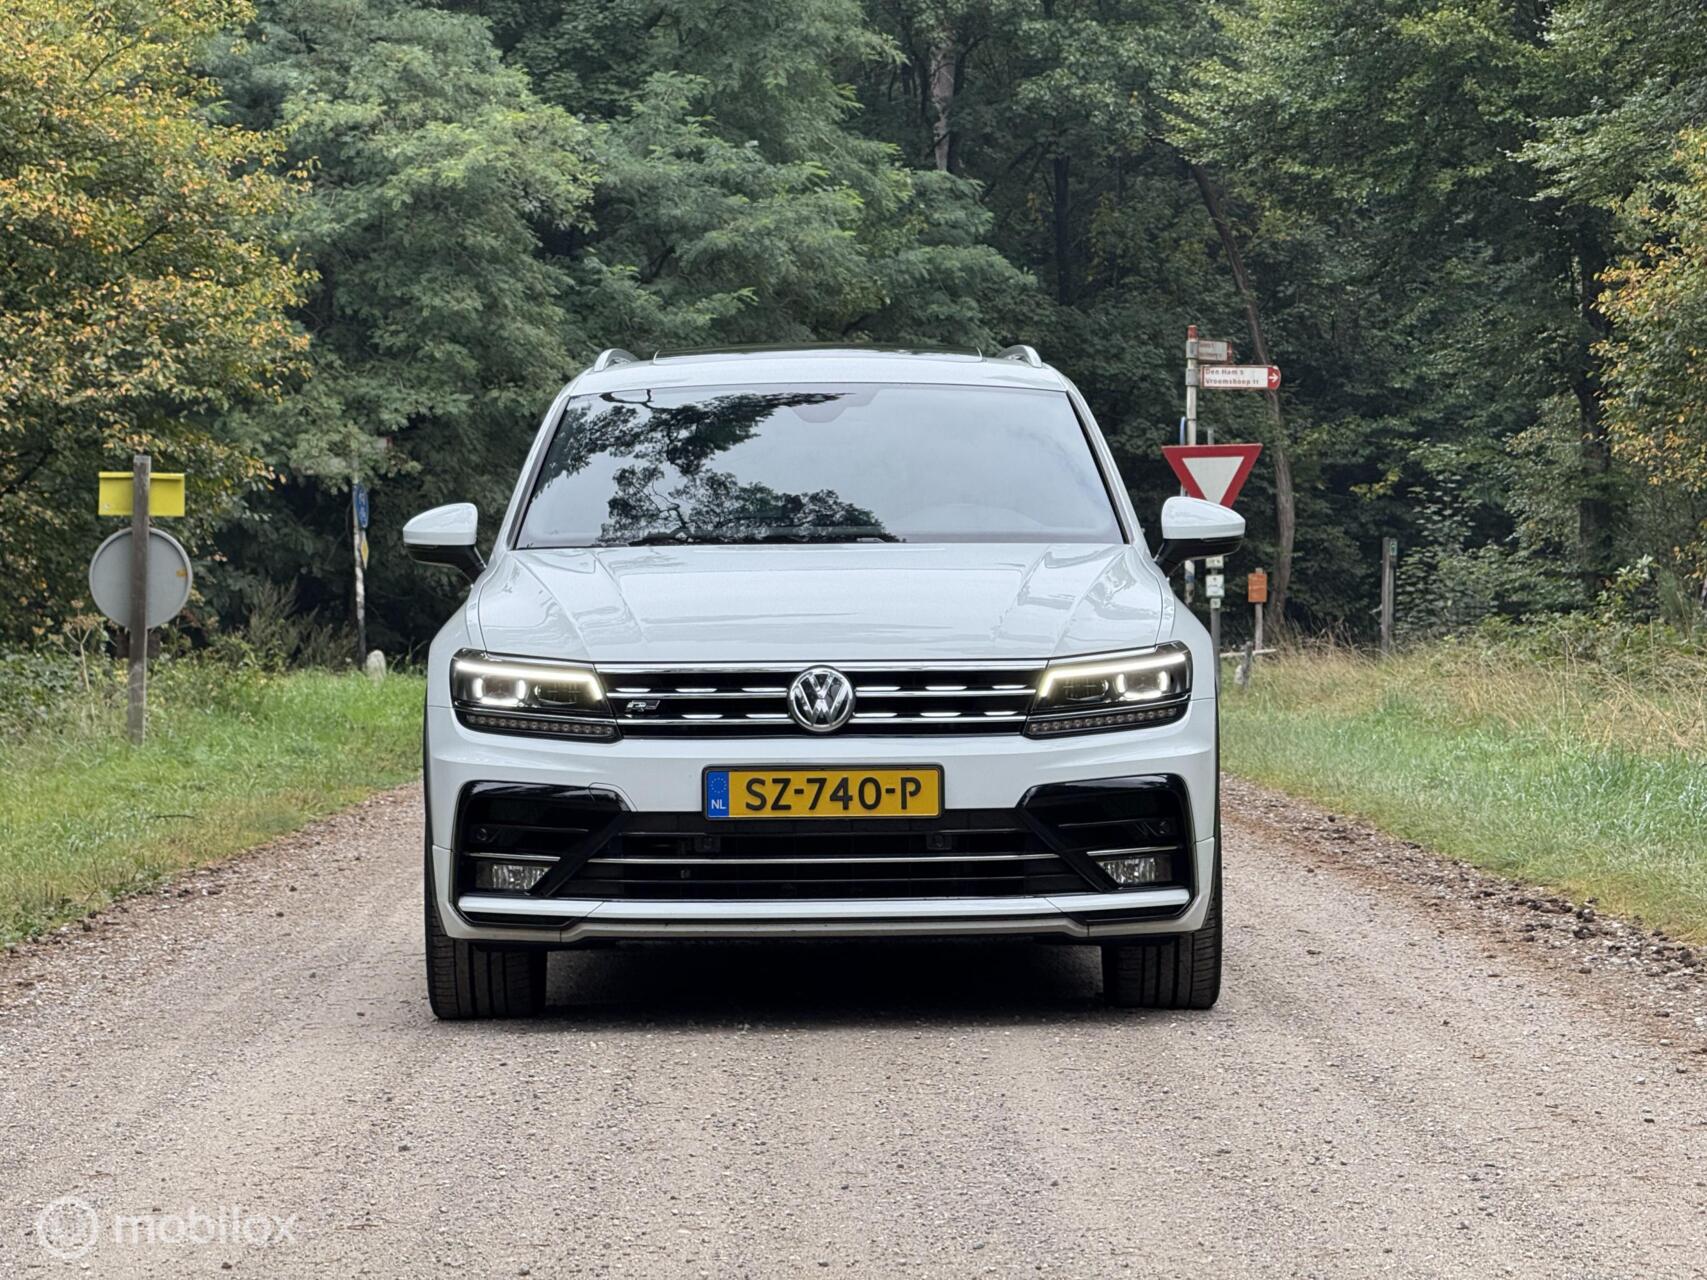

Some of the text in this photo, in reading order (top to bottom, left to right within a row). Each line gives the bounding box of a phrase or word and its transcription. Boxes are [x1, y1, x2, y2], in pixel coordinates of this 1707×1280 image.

[793, 670, 851, 727] VW
[711, 799, 727, 810] NL
[745, 776, 922, 811] SZ-740-P
